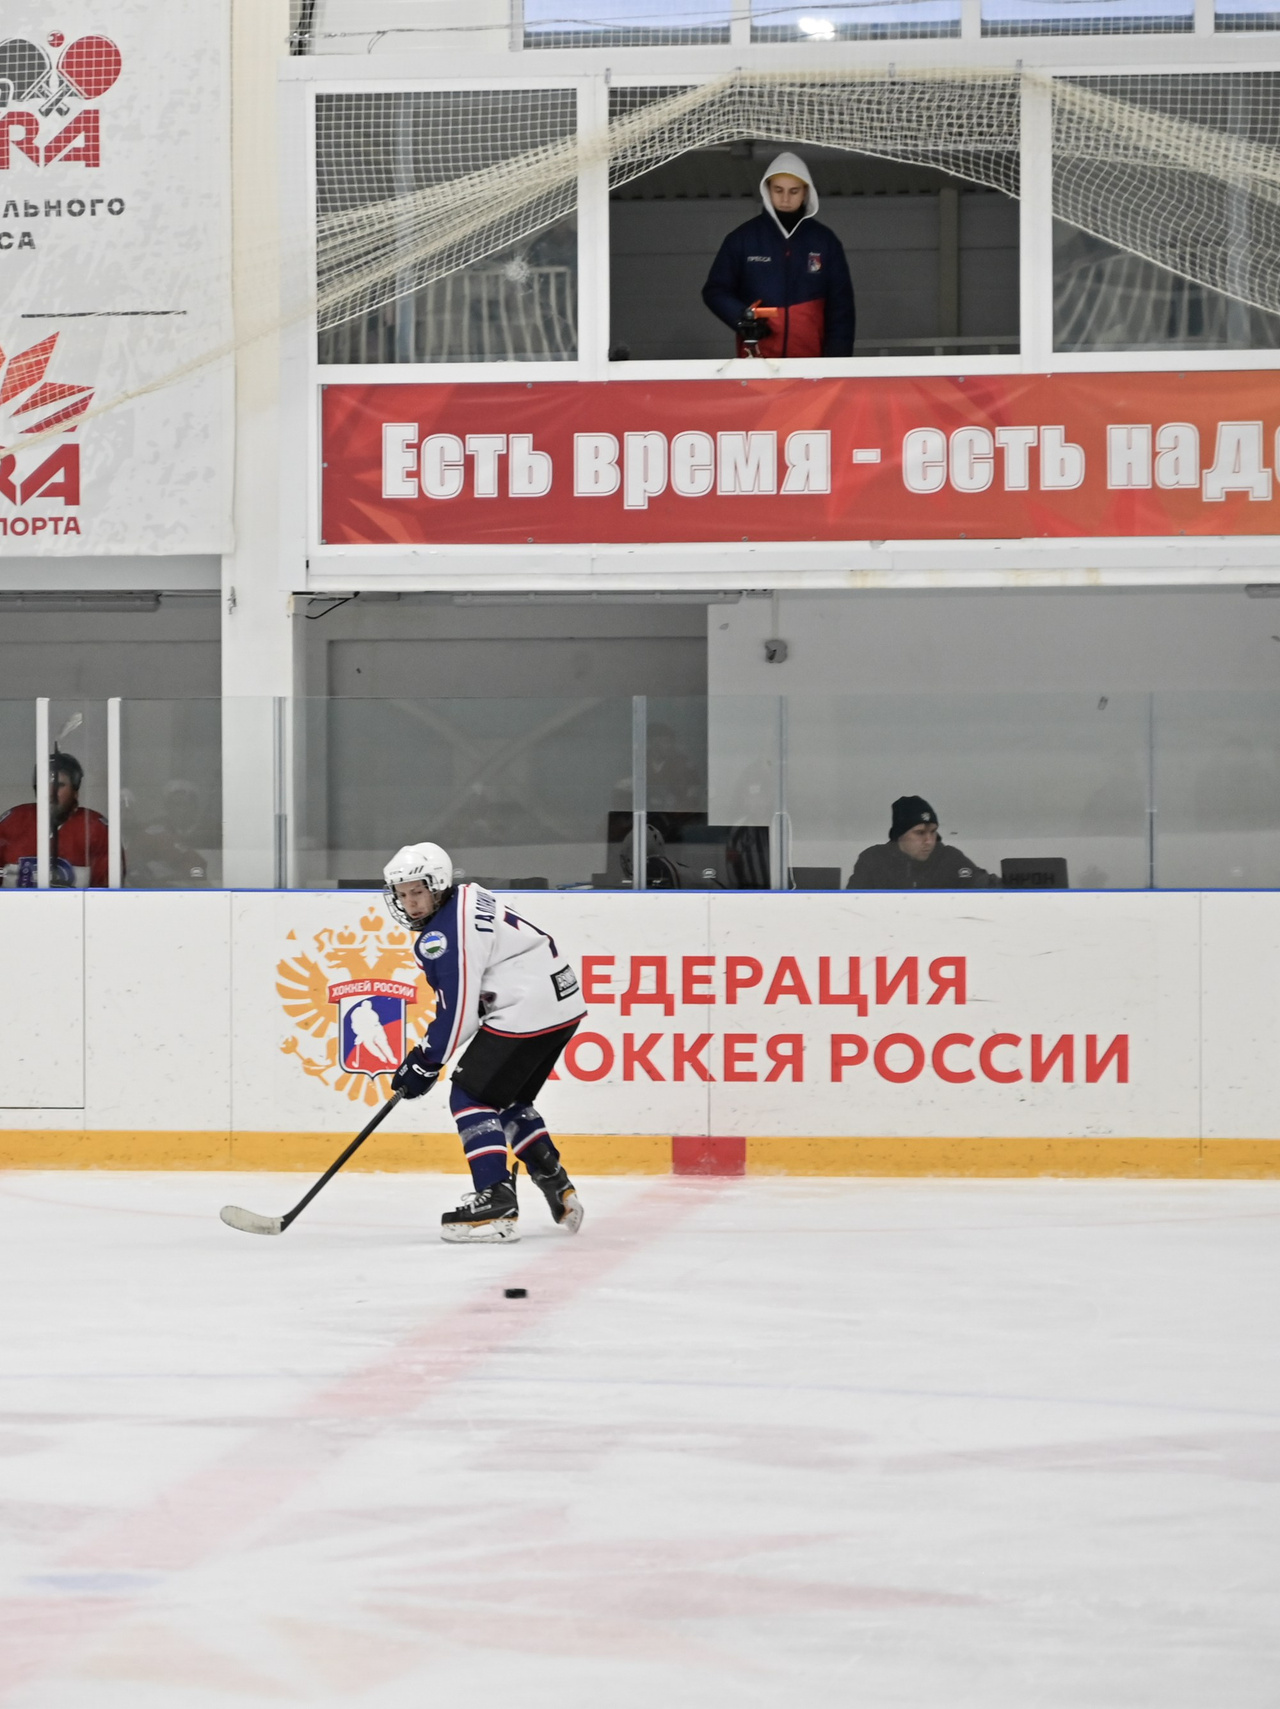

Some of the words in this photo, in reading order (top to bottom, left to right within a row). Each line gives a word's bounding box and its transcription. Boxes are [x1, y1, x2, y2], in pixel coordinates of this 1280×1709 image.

[381, 422, 554, 499] Есть
[573, 430, 832, 510] время
[901, 425, 1086, 494] есть
[1106, 421, 1280, 502] над
[373, 981, 415, 998] РОССИИ
[581, 955, 967, 1017] ЕДЕРАЦИЯ
[547, 1031, 804, 1084] ОККЕЯ
[830, 1033, 1130, 1084] РОССИИ
